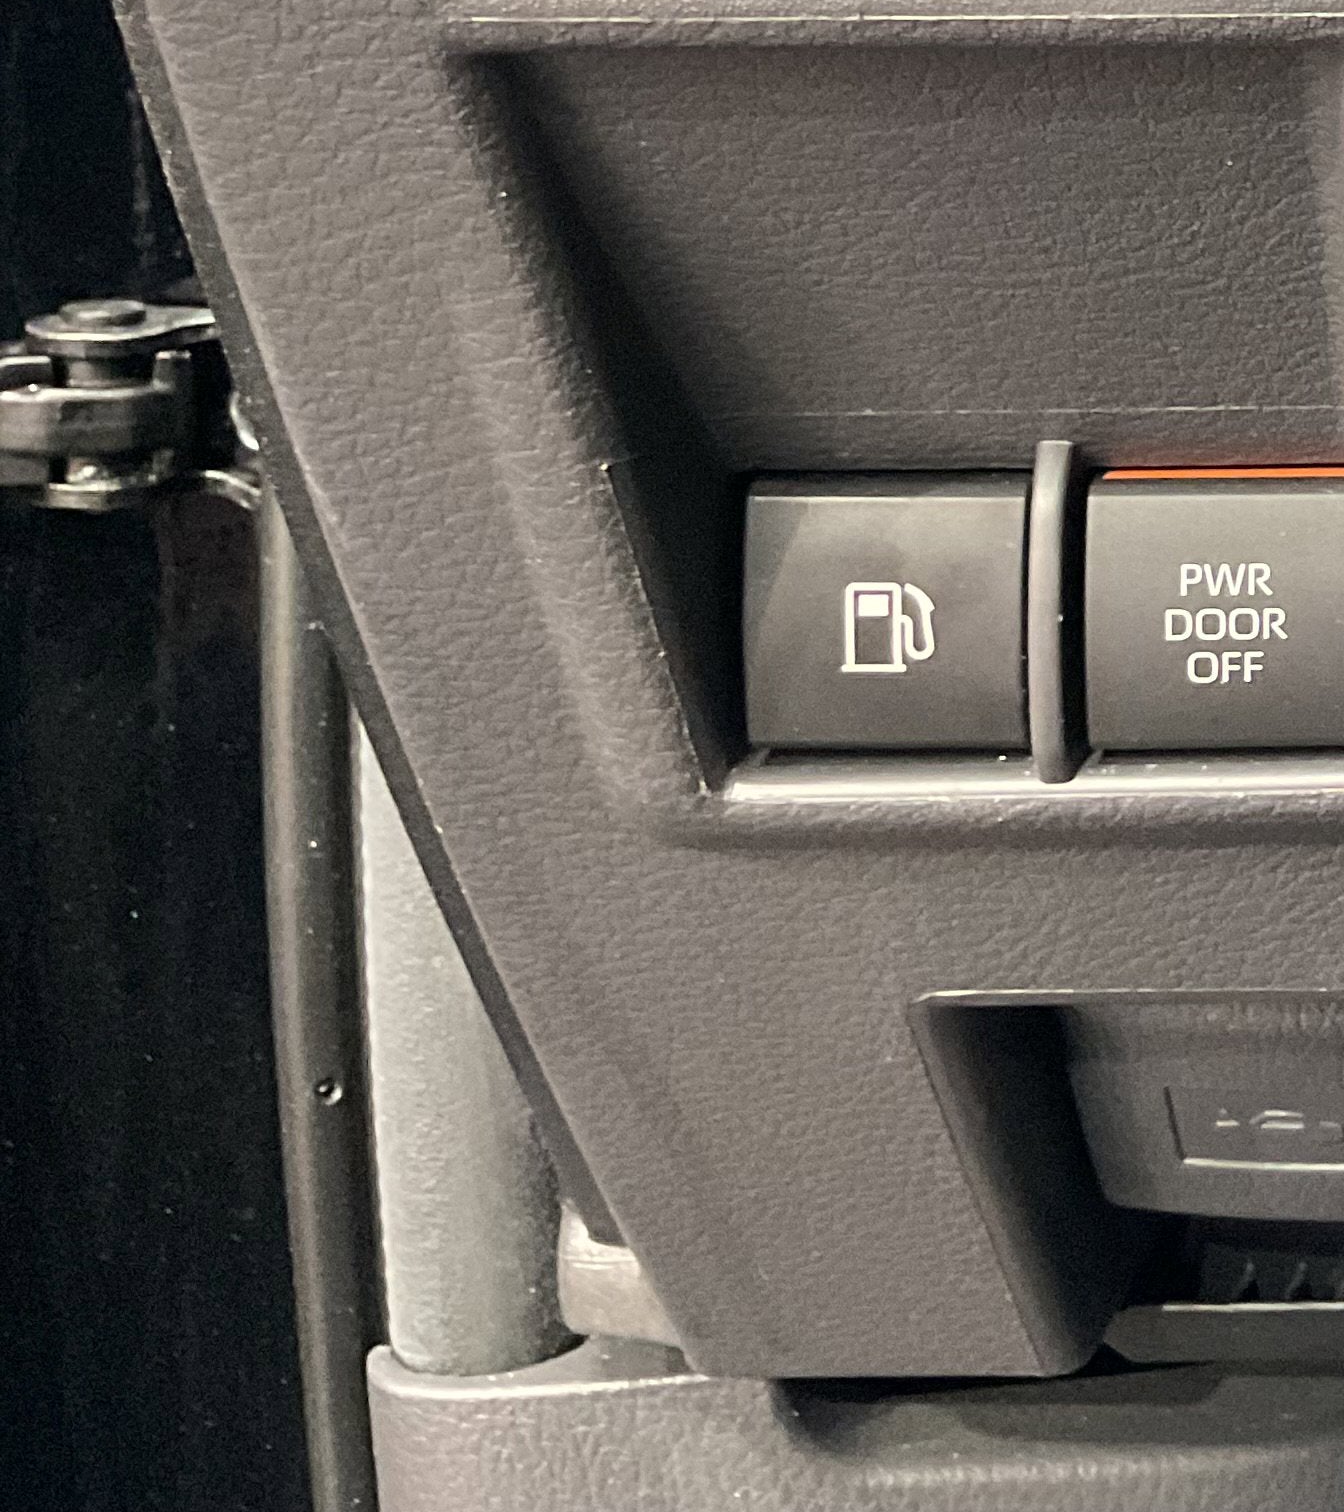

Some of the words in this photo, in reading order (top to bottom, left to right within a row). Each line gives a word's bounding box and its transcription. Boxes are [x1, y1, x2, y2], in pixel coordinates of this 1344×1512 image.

[1179, 562, 1274, 597] PWR
[1164, 607, 1289, 642] DOOR
[1186, 650, 1266, 685] OFF
